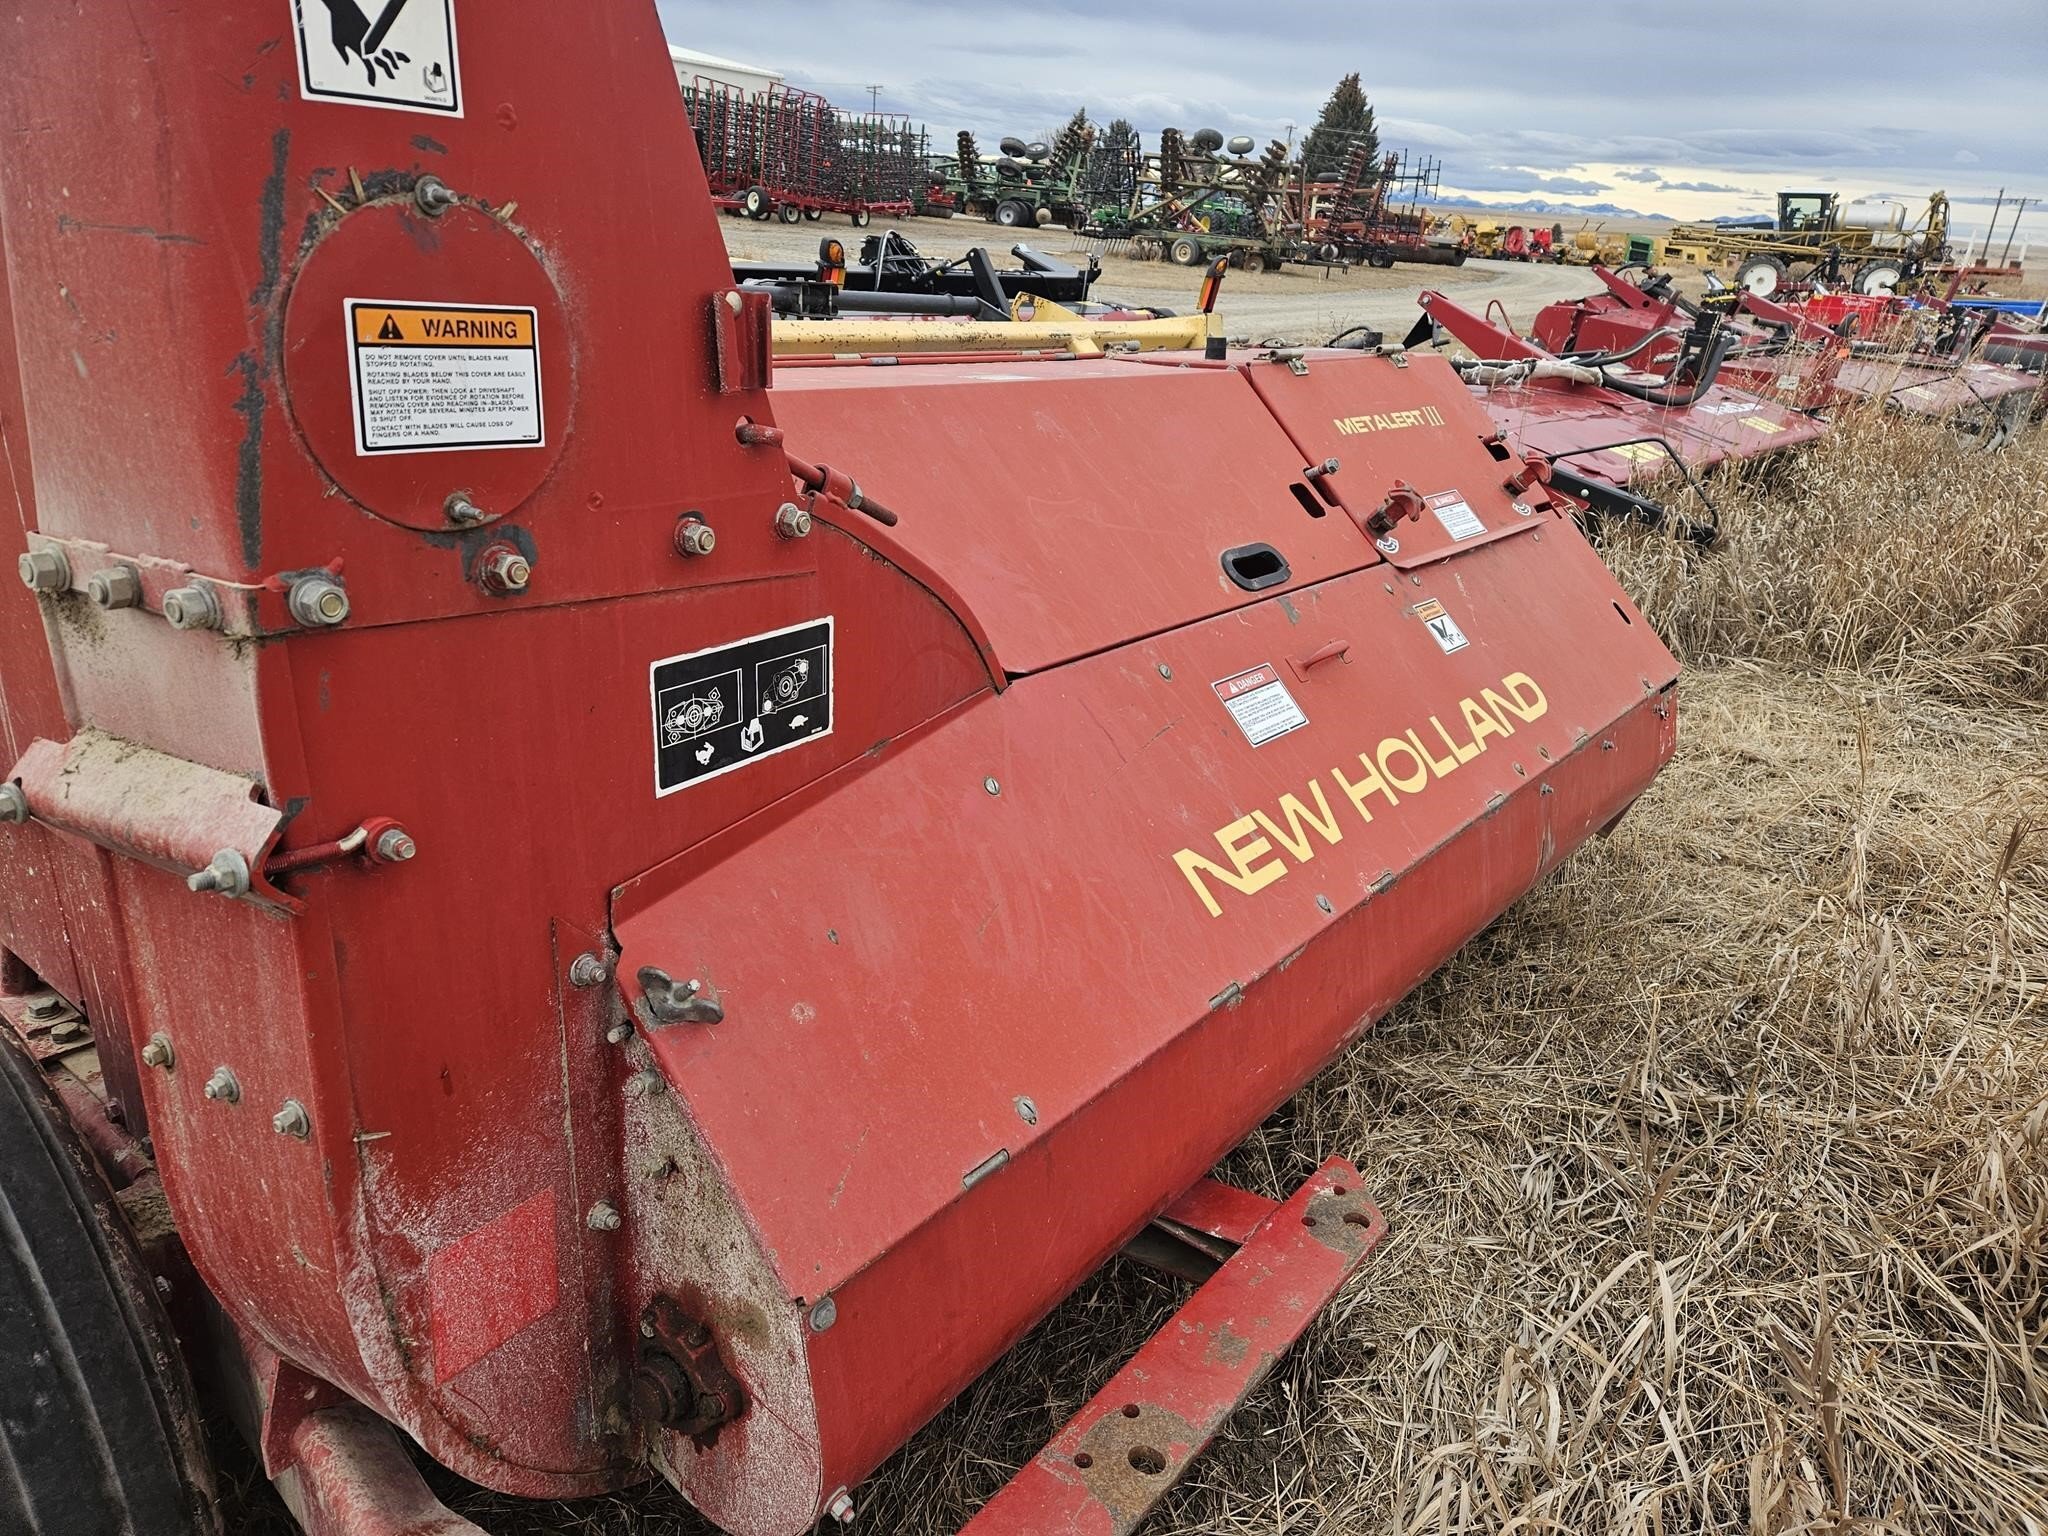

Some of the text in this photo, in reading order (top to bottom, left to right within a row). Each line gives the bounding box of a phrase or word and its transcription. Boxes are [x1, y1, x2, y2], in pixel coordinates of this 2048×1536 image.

[421, 318, 518, 339] WARNING
[1333, 410, 1424, 436] METALERT
[1236, 672, 1266, 689] DANGER
[1172, 671, 1548, 918] NEW HOLLAND
